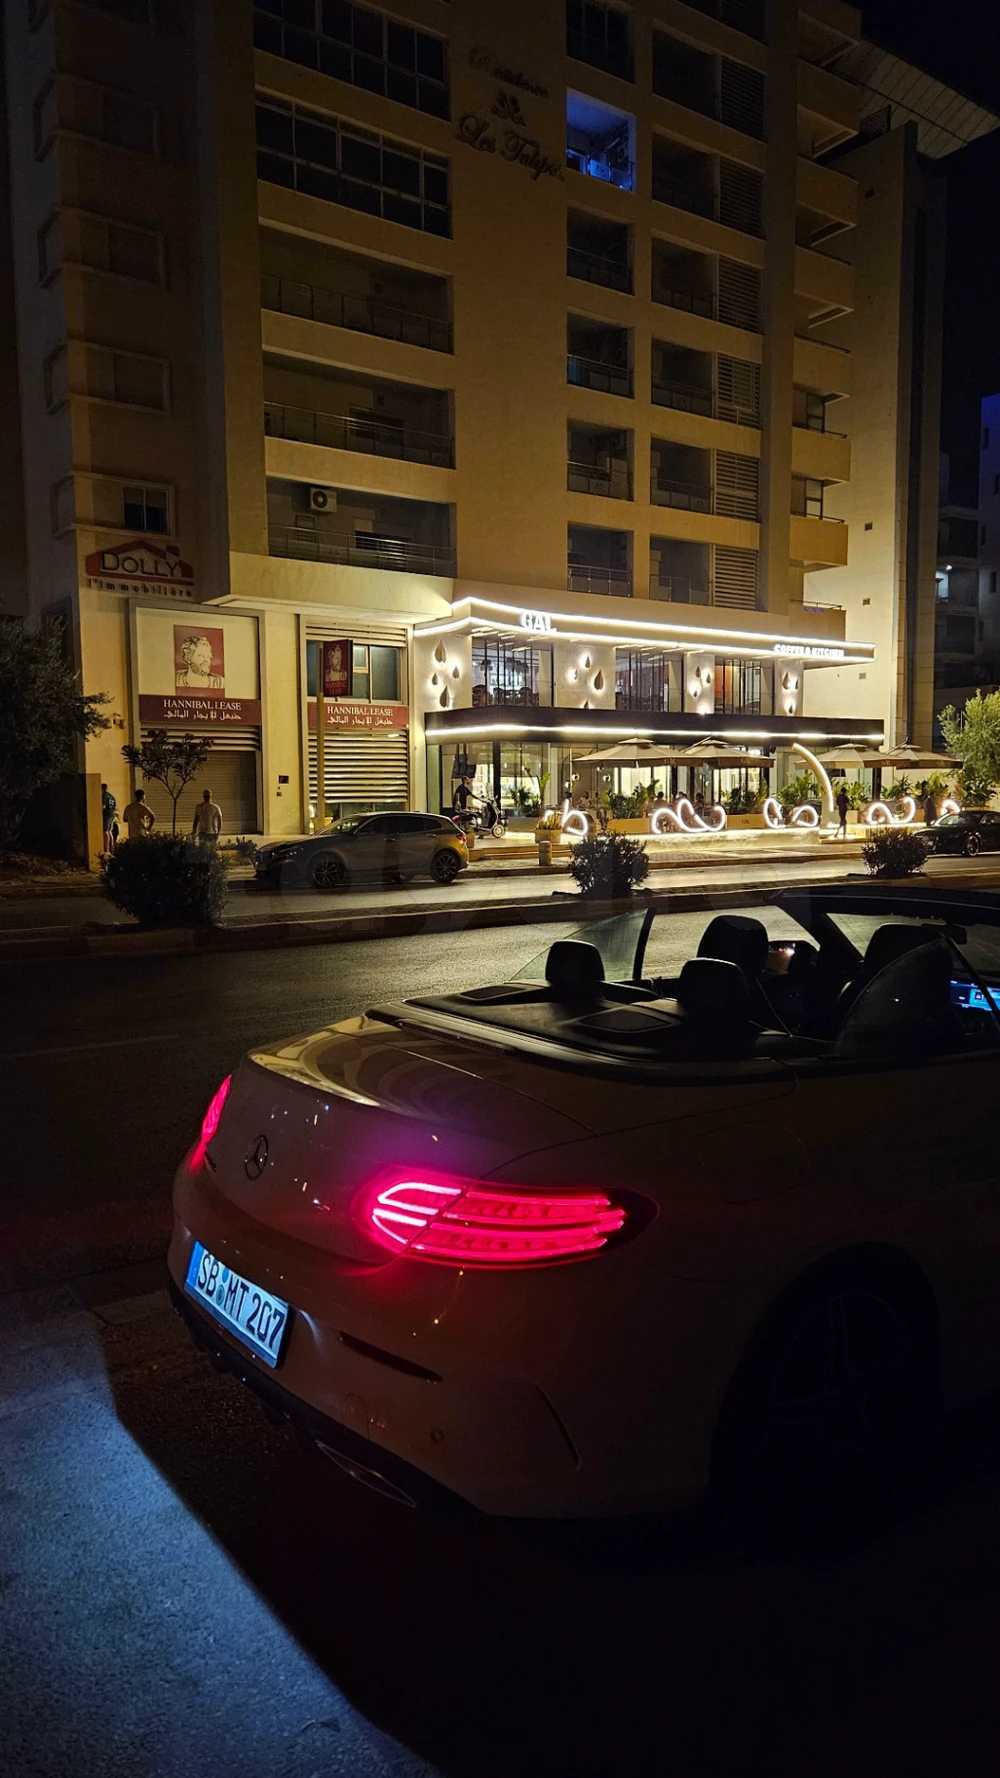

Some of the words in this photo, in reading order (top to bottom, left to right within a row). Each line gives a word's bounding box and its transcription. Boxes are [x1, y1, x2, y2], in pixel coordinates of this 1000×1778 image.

[163, 699, 214, 710] HANNIBAL
[215, 701, 242, 711] LEASE
[327, 706, 370, 715] HANNIBAL
[370, 708, 393, 716] LEASE
[198, 1253, 220, 1297] SB
[223, 1273, 250, 1322] MT
[246, 1292, 286, 1349] 207
